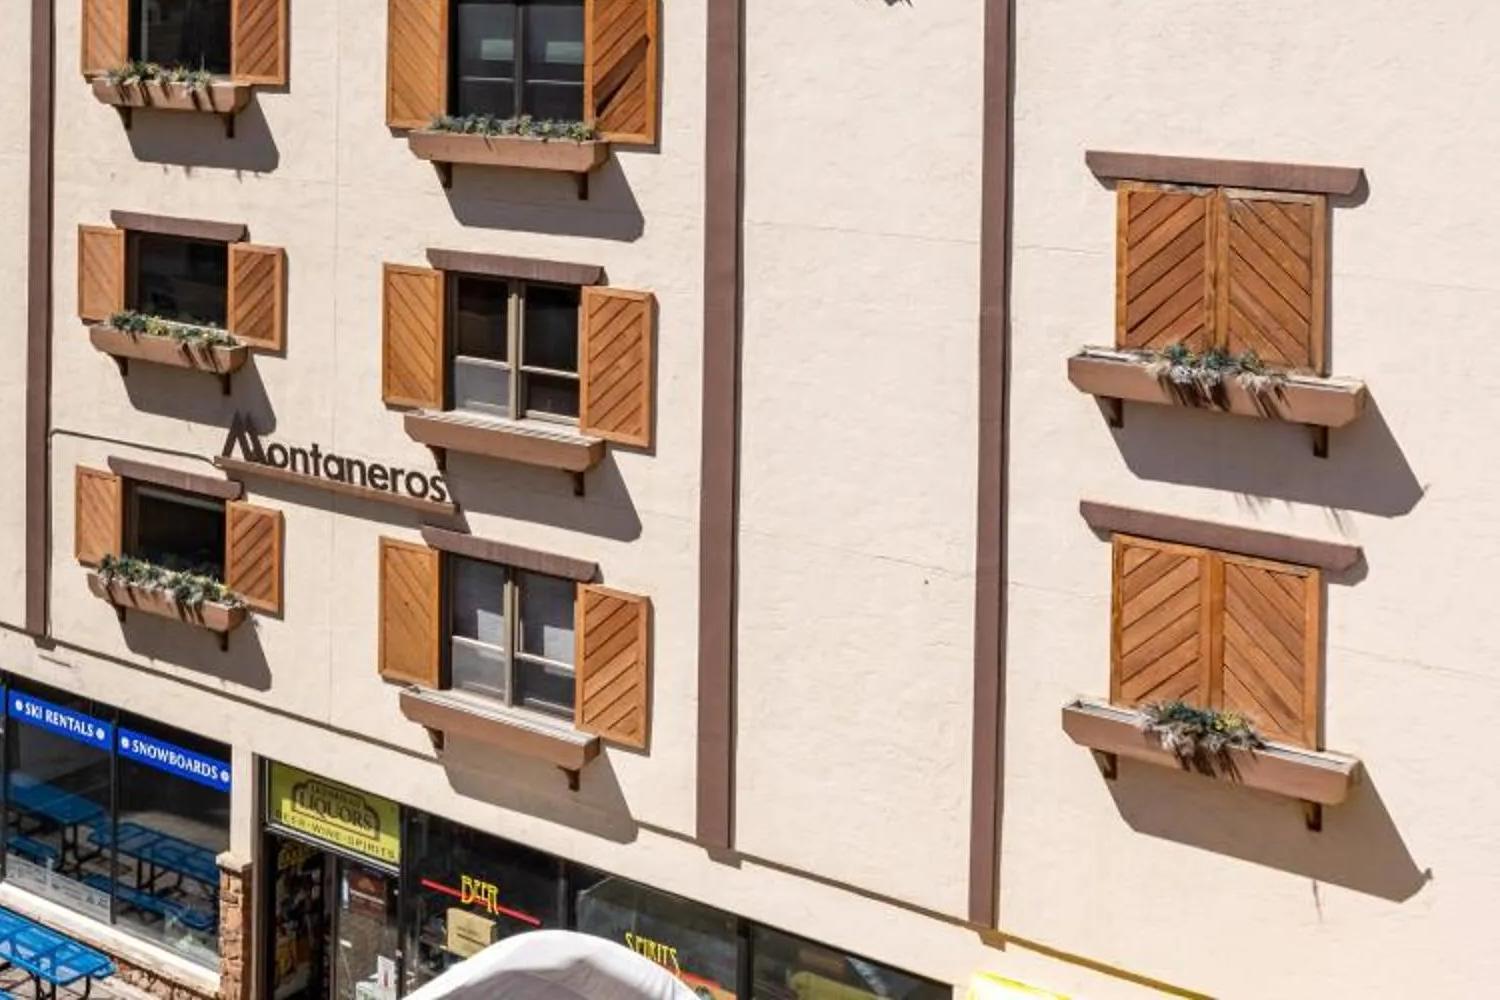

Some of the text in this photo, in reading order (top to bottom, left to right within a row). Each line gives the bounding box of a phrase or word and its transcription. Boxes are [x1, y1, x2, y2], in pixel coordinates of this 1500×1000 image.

[221, 408, 447, 502] Montaneros
[25, 701, 95, 737] SKI RENTALS
[131, 739, 219, 780] SNOWBOARDS
[299, 789, 376, 832] LIQUORS
[311, 821, 341, 842] WINE
[347, 834, 396, 859] SPIRITS
